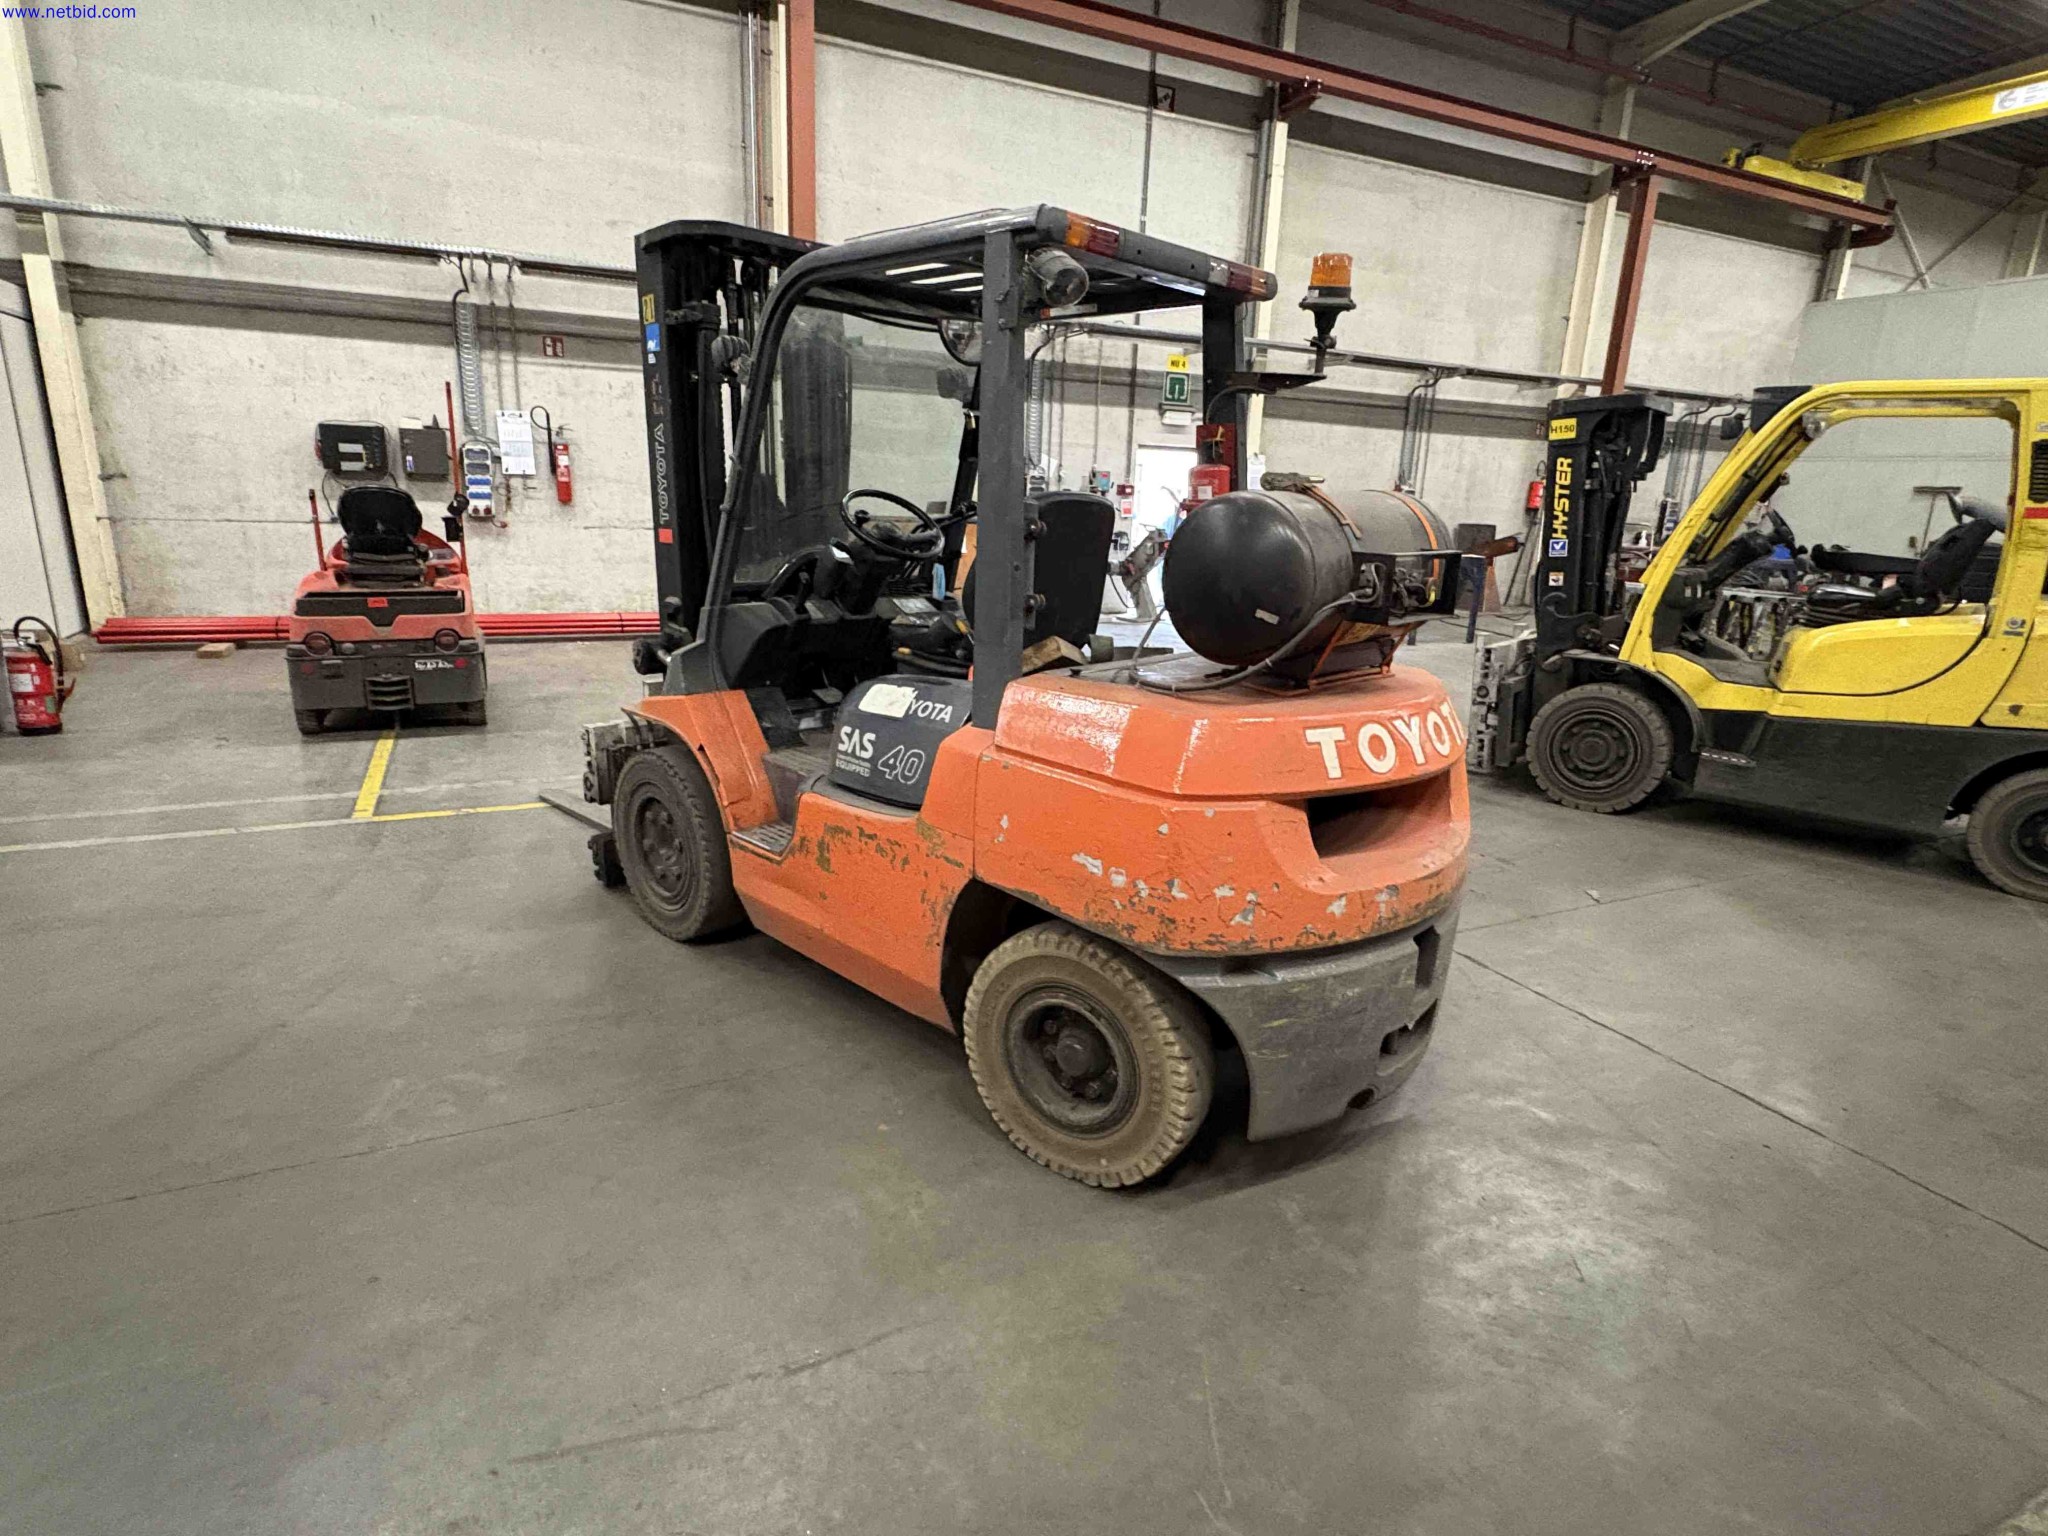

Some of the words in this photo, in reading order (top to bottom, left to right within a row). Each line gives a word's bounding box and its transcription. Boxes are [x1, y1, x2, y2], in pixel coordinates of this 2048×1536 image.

[1550, 423, 1576, 434] H150
[653, 422, 670, 524] TOYOTA
[1551, 457, 1573, 539] HYSTER
[908, 698, 953, 723] YOTA
[838, 726, 876, 759] SAS
[1304, 697, 1466, 780] TOYOT
[835, 758, 871, 778] EQUIPPED
[877, 745, 925, 785] 40
